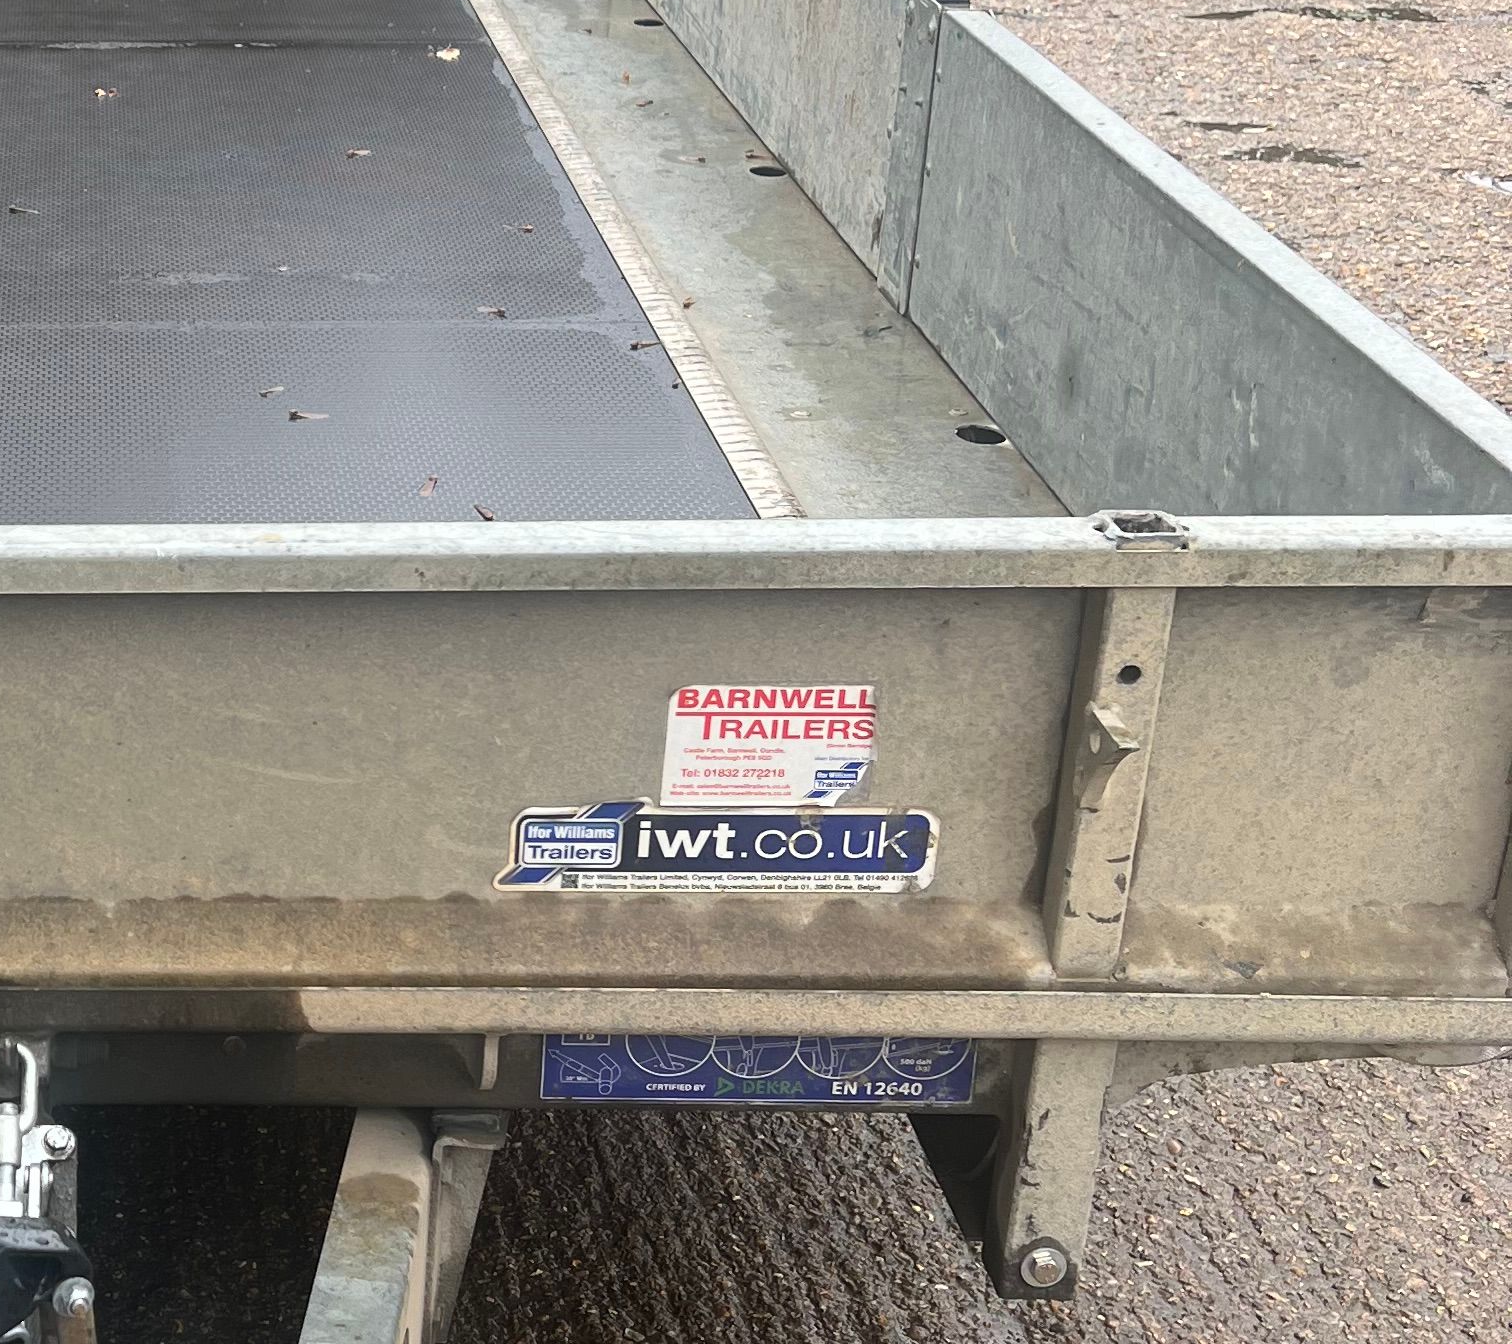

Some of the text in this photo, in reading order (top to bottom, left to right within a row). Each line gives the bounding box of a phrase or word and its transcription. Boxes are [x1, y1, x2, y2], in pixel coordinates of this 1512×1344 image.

[677, 688, 876, 710] BARNWELL
[701, 714, 875, 741] TRAILERS
[680, 768, 785, 778] Tel: 01832 272218
[527, 824, 615, 840] Ifor Williams
[637, 820, 909, 859] iwt.co.uk
[528, 843, 613, 860] Trailers
[645, 1083, 706, 1092] CERTIFIED BY
[743, 1080, 805, 1095] DEKRA
[831, 1081, 924, 1096] EN 12640
